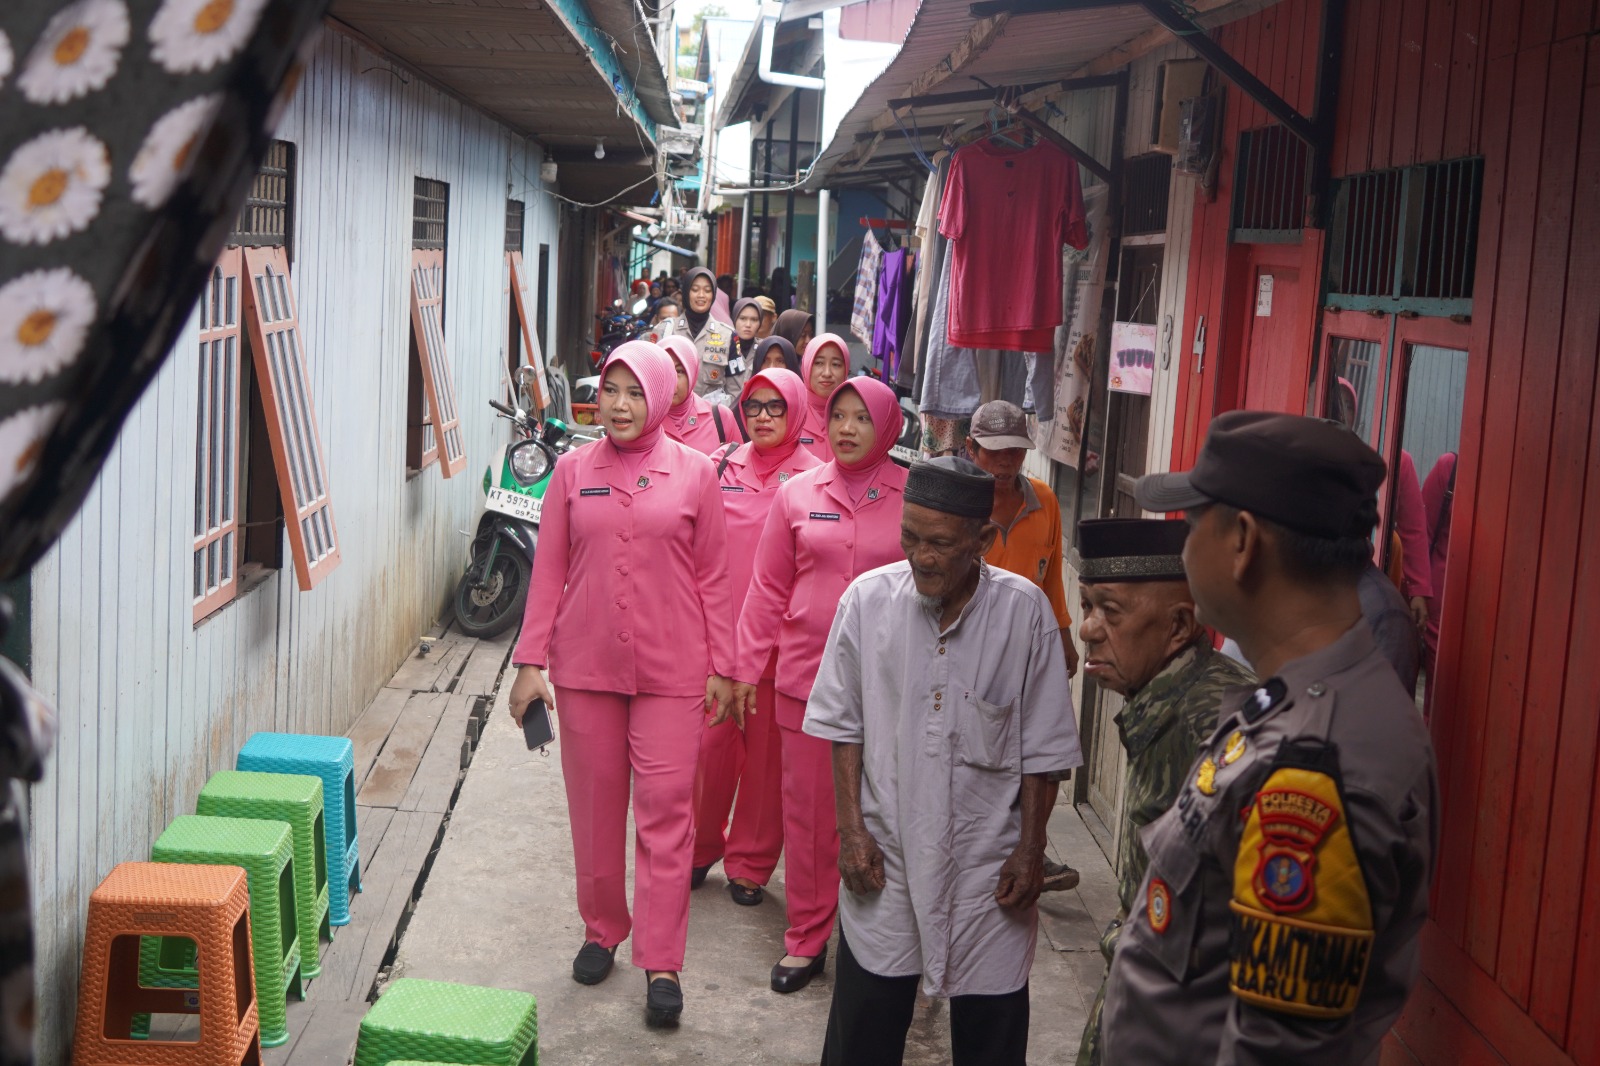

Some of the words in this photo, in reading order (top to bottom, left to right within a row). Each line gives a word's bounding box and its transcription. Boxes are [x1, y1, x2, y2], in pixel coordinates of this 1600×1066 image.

[704, 346, 727, 354] POLRI
[1193, 315, 1205, 374] 4
[490, 489, 503, 500] KT
[506, 494, 534, 508] 5975
[1260, 791, 1332, 817] POLRESTA
